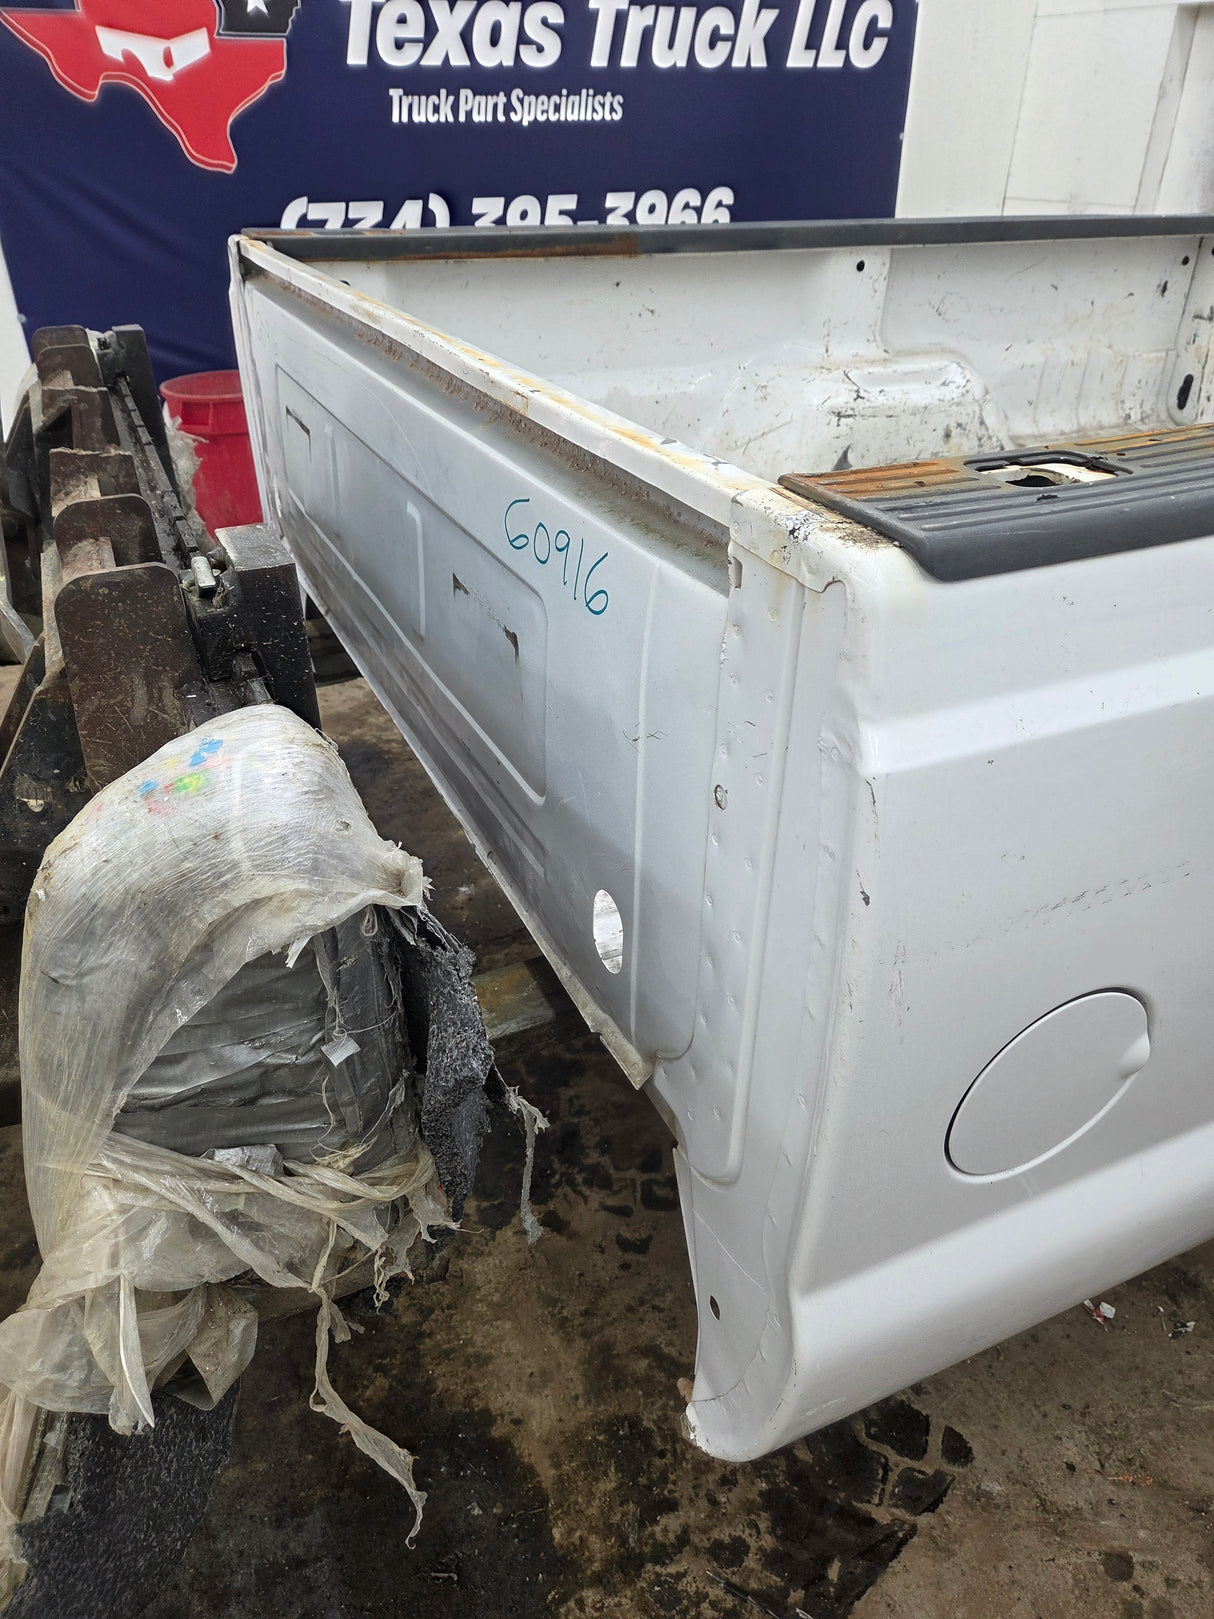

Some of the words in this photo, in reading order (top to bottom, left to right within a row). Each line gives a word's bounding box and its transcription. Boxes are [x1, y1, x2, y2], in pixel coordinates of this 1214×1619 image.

[338, 0, 565, 68] Texas
[588, 0, 780, 68] Truck
[786, 0, 894, 68] LLC
[388, 88, 454, 123] Truck
[458, 88, 507, 123] Part
[509, 88, 624, 126] Specialists
[504, 498, 609, 616] 60916
